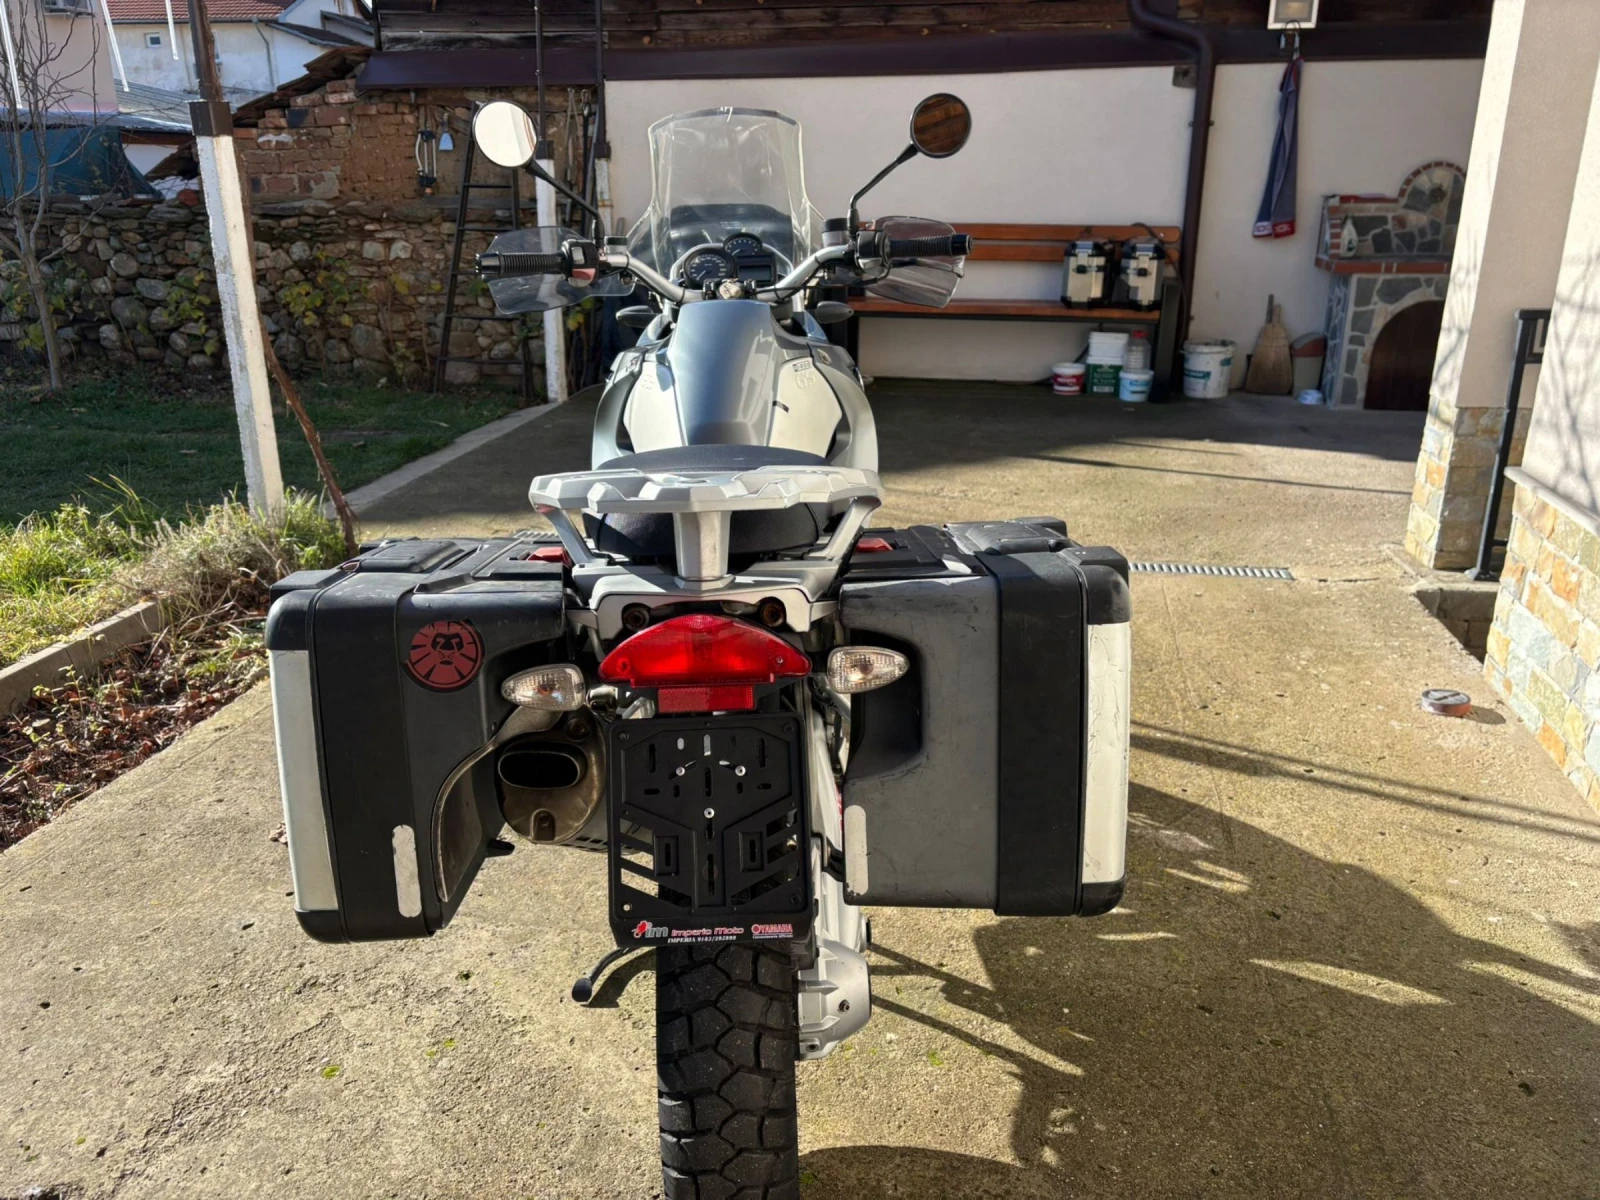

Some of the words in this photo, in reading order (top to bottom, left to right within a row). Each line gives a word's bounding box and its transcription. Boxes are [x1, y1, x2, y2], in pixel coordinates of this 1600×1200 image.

[714, 926, 744, 935] Moto
[760, 923, 793, 933] YAMAHA
[667, 936, 696, 944] IMPERIA
